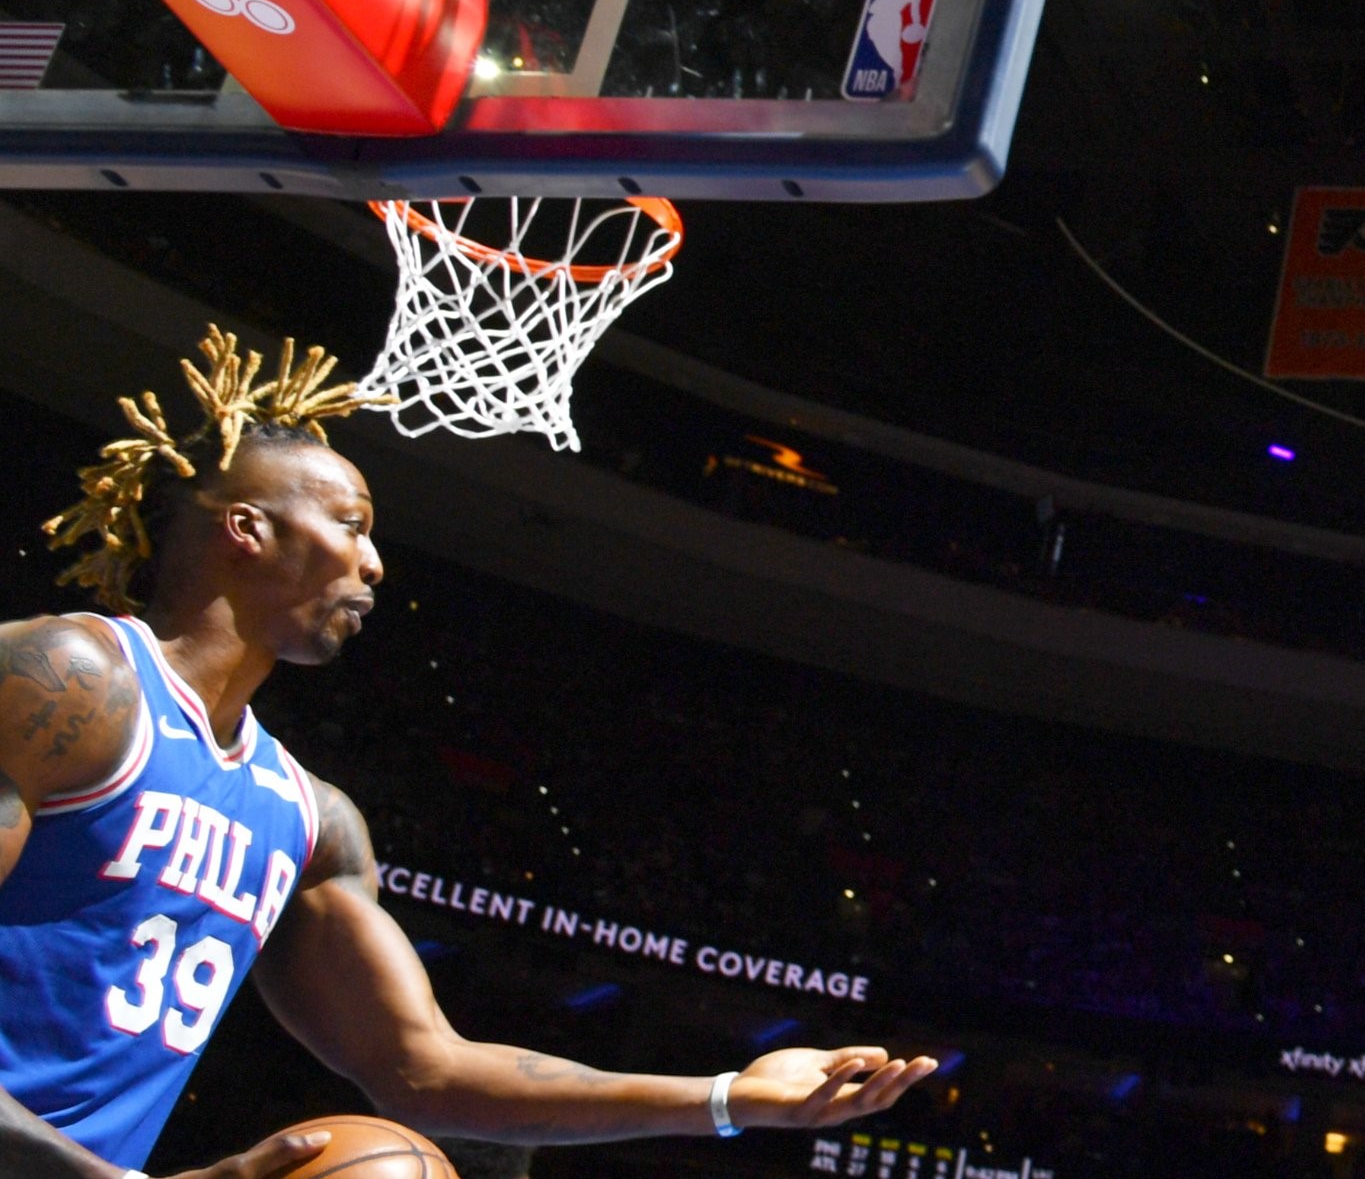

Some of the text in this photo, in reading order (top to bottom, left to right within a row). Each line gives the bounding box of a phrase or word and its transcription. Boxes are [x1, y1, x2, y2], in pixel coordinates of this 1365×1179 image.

[852, 68, 889, 93] NBA
[375, 861, 872, 1003] XCELLENT IN-HOME COVERAGE
[105, 913, 236, 1057] 39
[1280, 1045, 1345, 1077] xfinity
